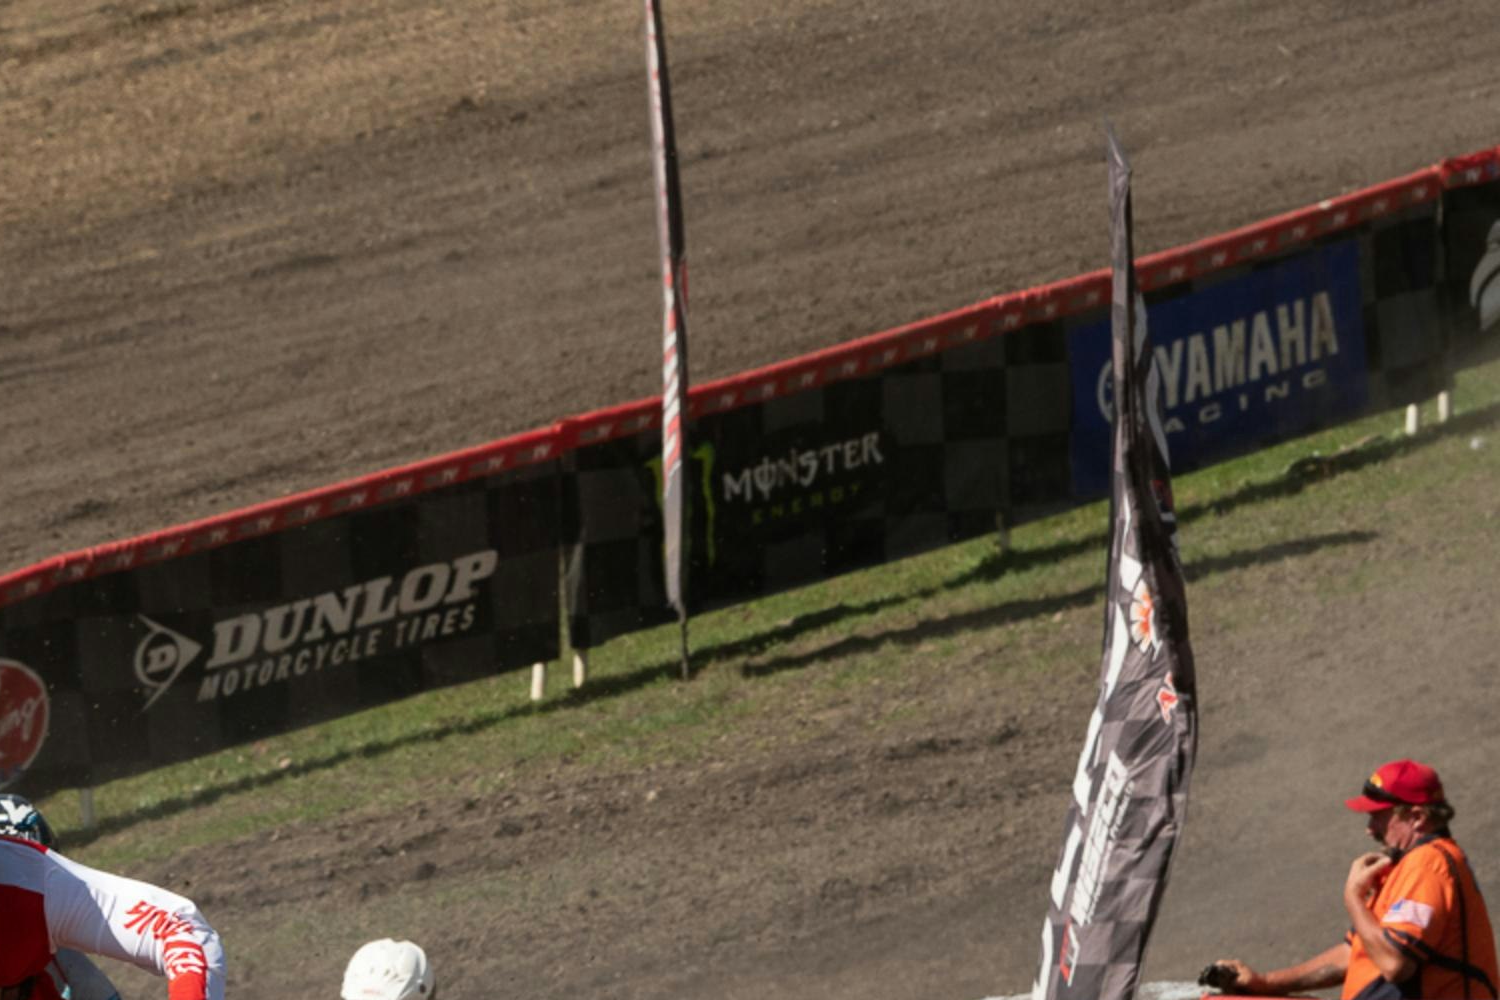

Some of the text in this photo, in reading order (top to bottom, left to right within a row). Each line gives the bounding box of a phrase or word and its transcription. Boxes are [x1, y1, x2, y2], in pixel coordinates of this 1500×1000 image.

[1154, 292, 1339, 409] YAMAHA
[1164, 368, 1328, 432] ACING
[721, 431, 884, 501] MONSTER
[197, 603, 477, 702] MOTORCYCLE TIRES
[206, 549, 499, 669] DUNLOP
